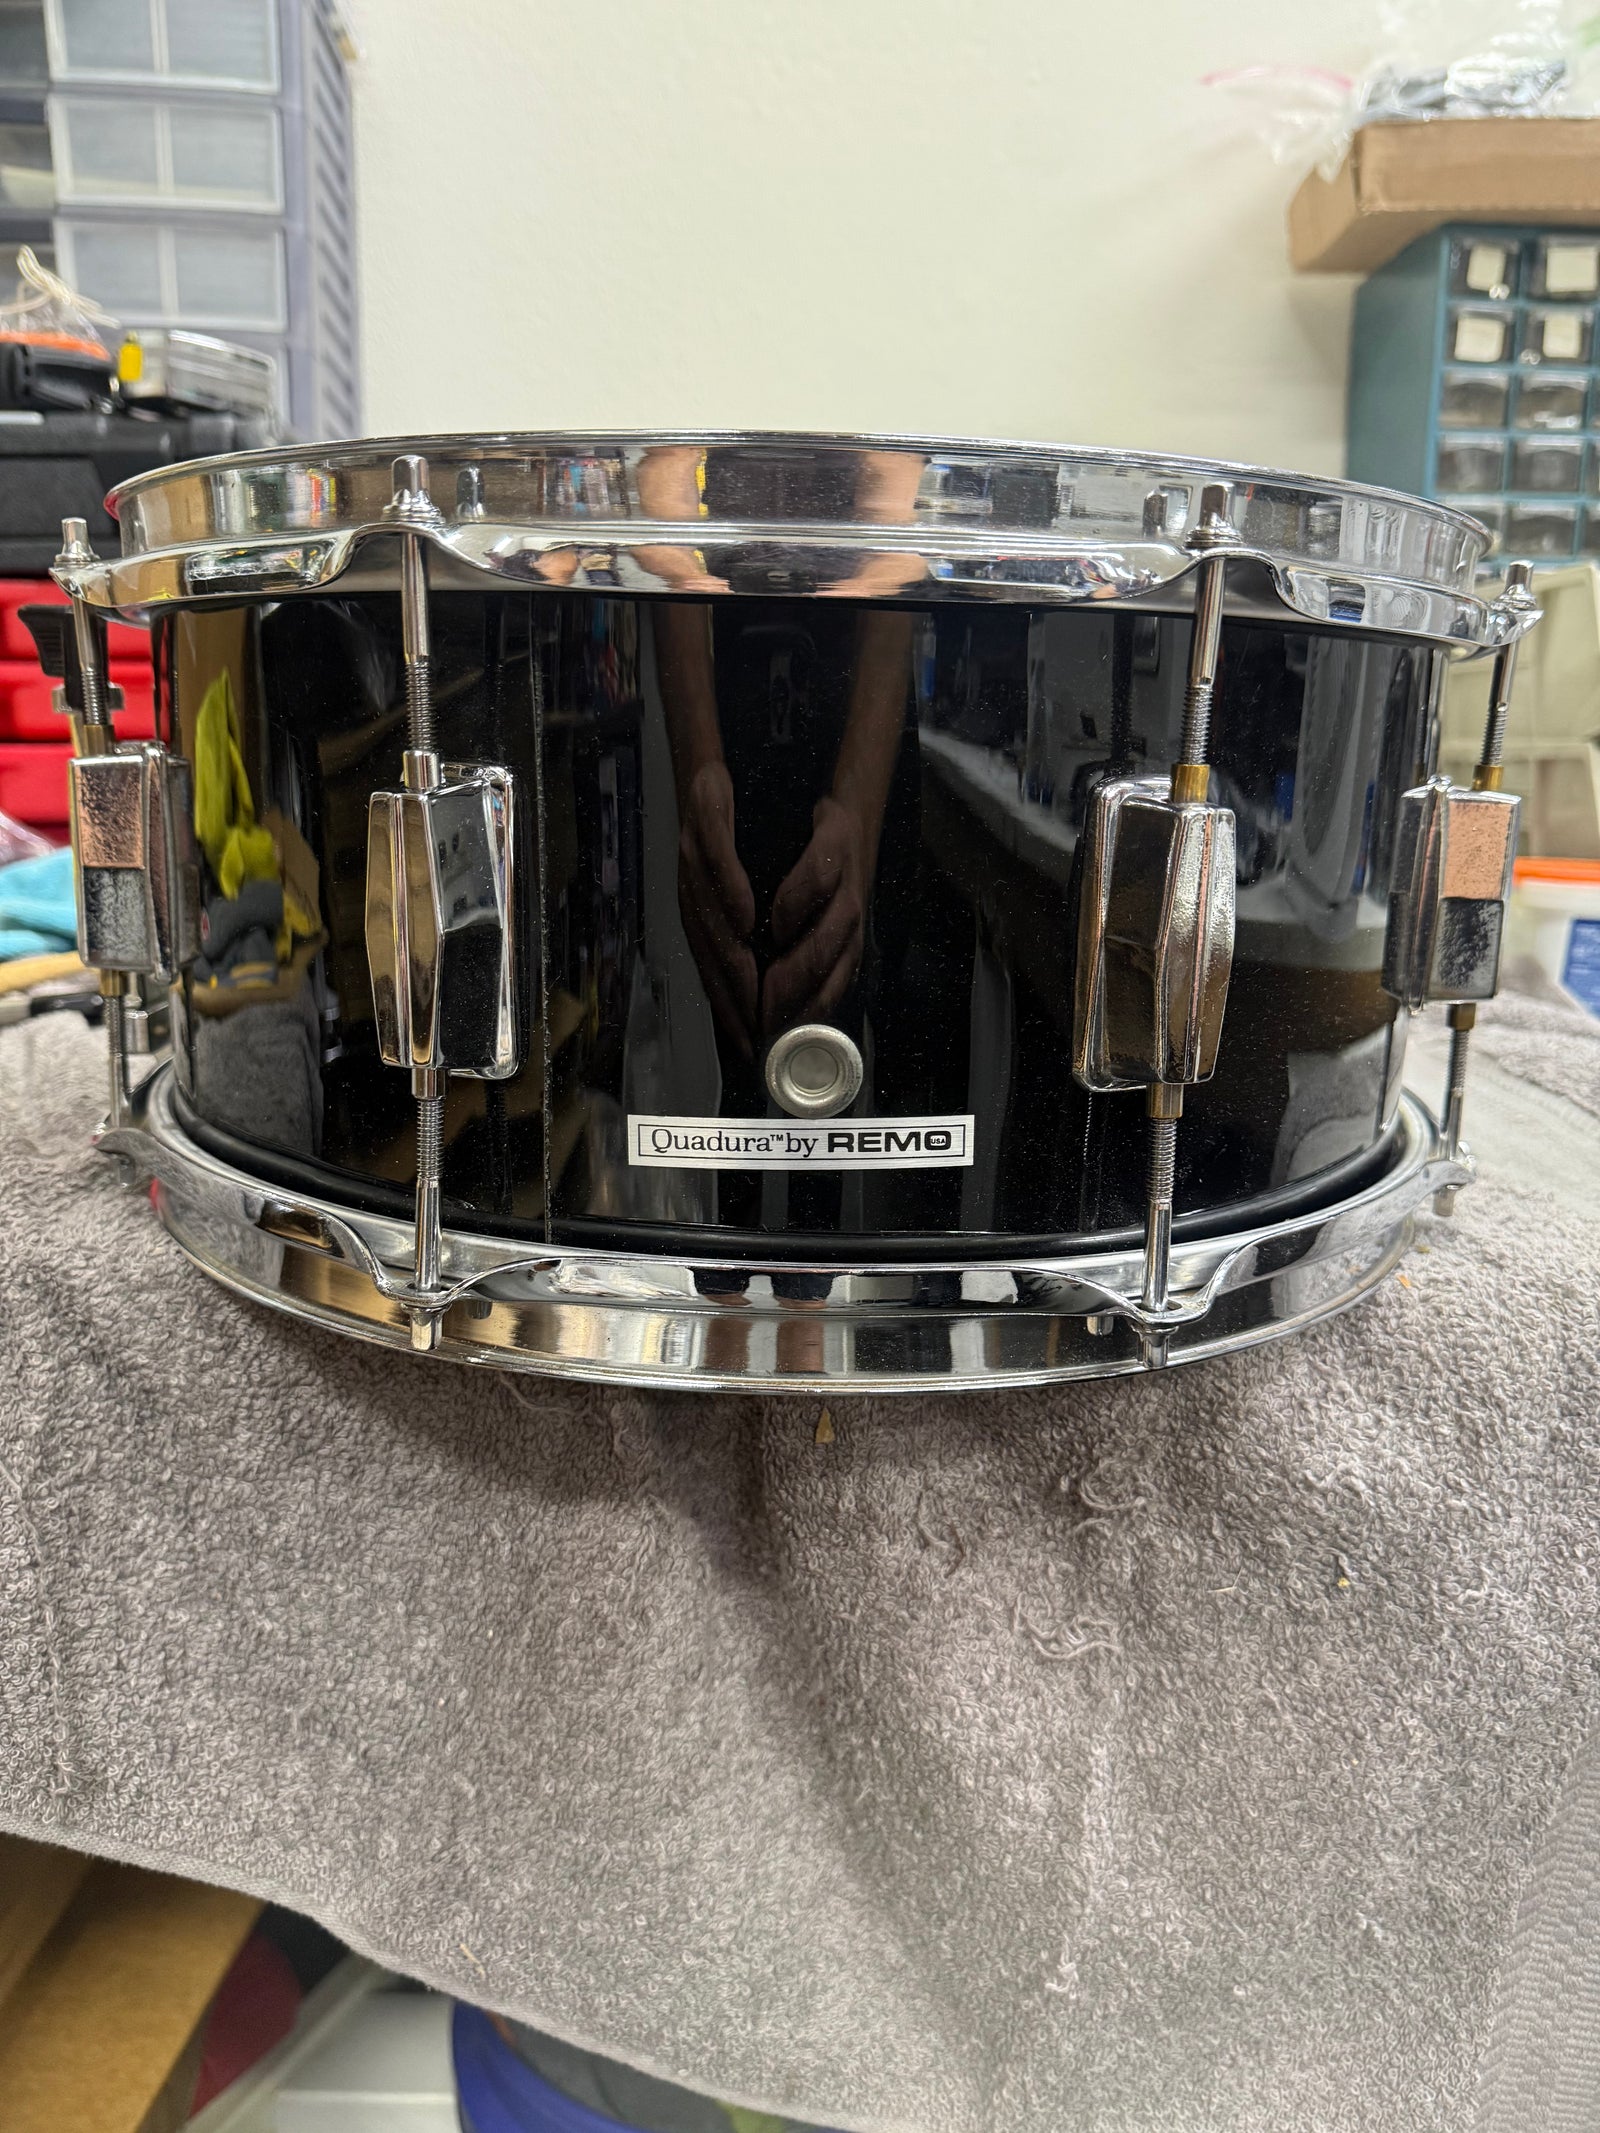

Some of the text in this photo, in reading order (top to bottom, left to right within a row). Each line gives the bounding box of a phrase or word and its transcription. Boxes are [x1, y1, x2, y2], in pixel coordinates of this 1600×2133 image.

[786, 1132, 819, 1158] by
[827, 1130, 951, 1153] REMO
[930, 1137, 946, 1145] USA
